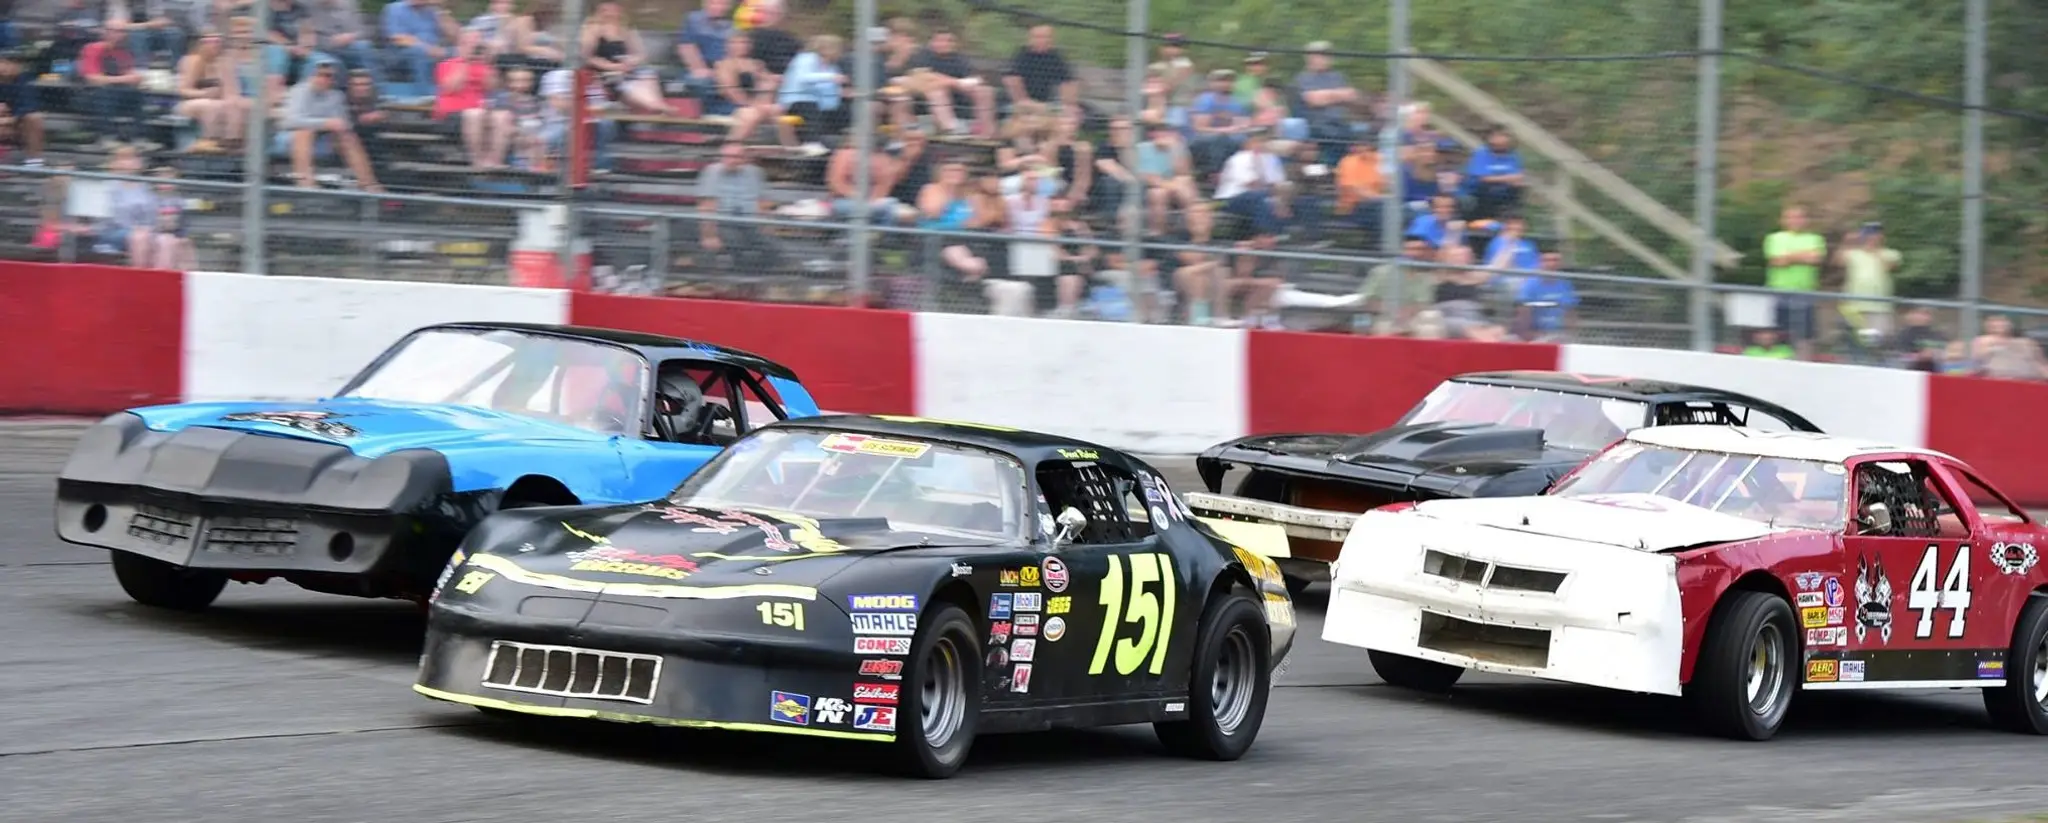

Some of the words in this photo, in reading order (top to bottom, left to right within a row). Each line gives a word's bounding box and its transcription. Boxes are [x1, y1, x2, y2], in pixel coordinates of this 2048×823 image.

[1909, 546, 1971, 637] 44
[853, 595, 916, 609] MOOG
[756, 601, 805, 631] 151
[1088, 552, 1175, 675] 151
[851, 614, 918, 630] MAHLE
[857, 639, 897, 650] COMP
[1843, 663, 1864, 673] MAHLE
